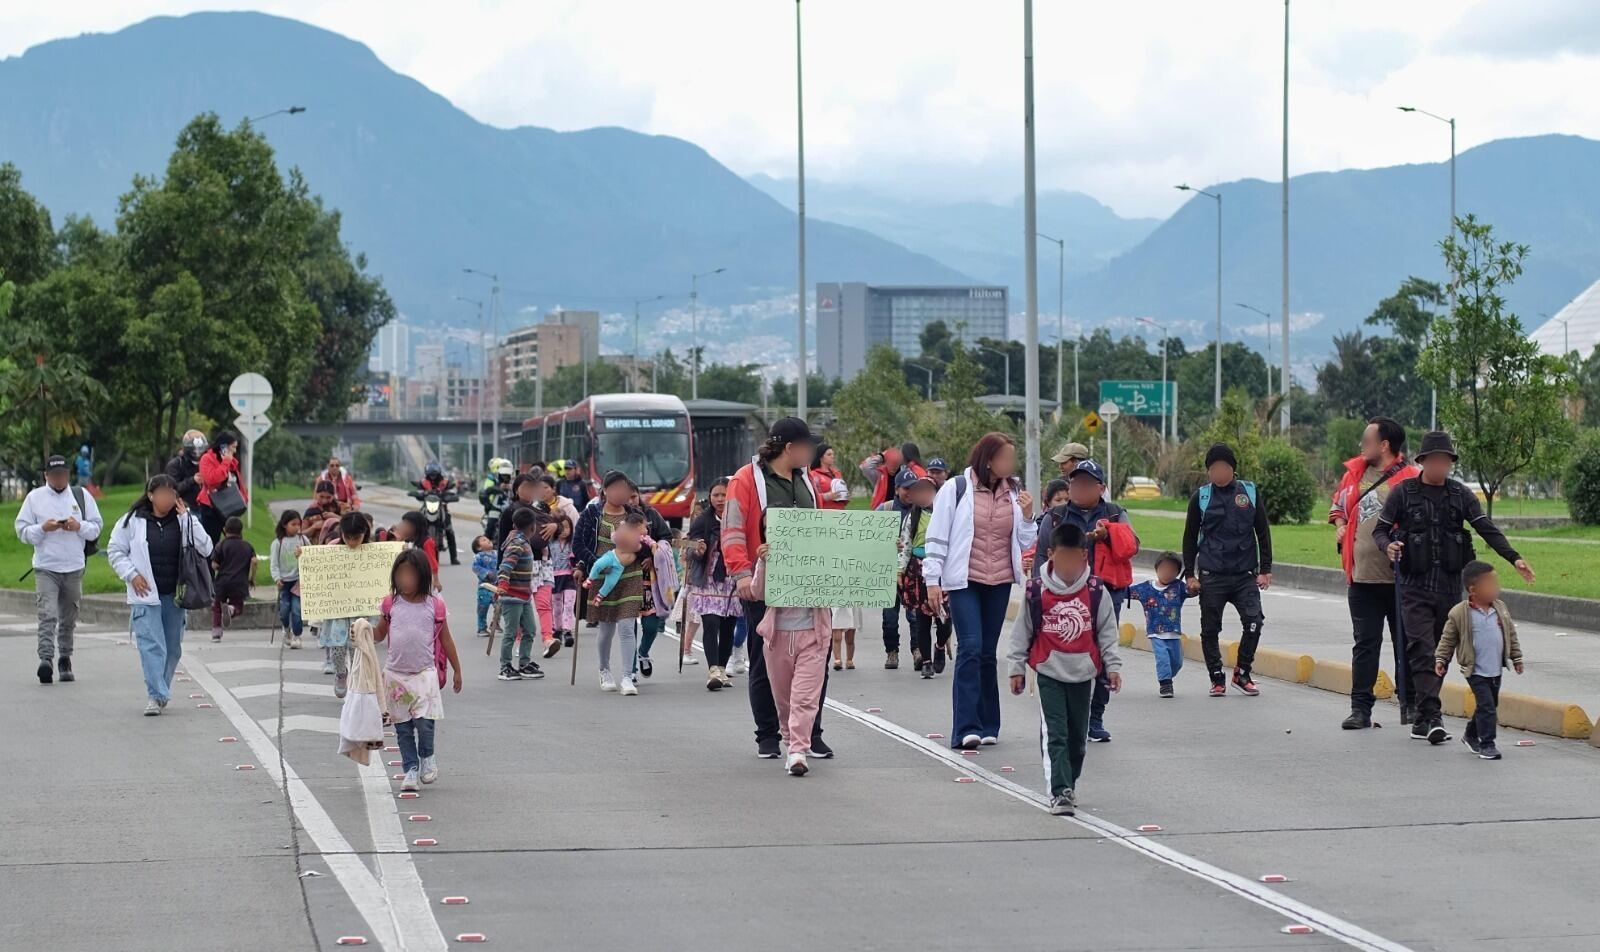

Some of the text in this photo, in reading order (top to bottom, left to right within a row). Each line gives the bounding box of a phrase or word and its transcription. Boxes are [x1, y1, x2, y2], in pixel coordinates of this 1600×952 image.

[969, 287, 1002, 298] Hilton
[642, 419, 652, 428] EL
[652, 419, 676, 428] DORADO
[831, 557, 893, 575] INFANCIA
[777, 573, 843, 587] MINISTERIO
[848, 576, 861, 586] DE
